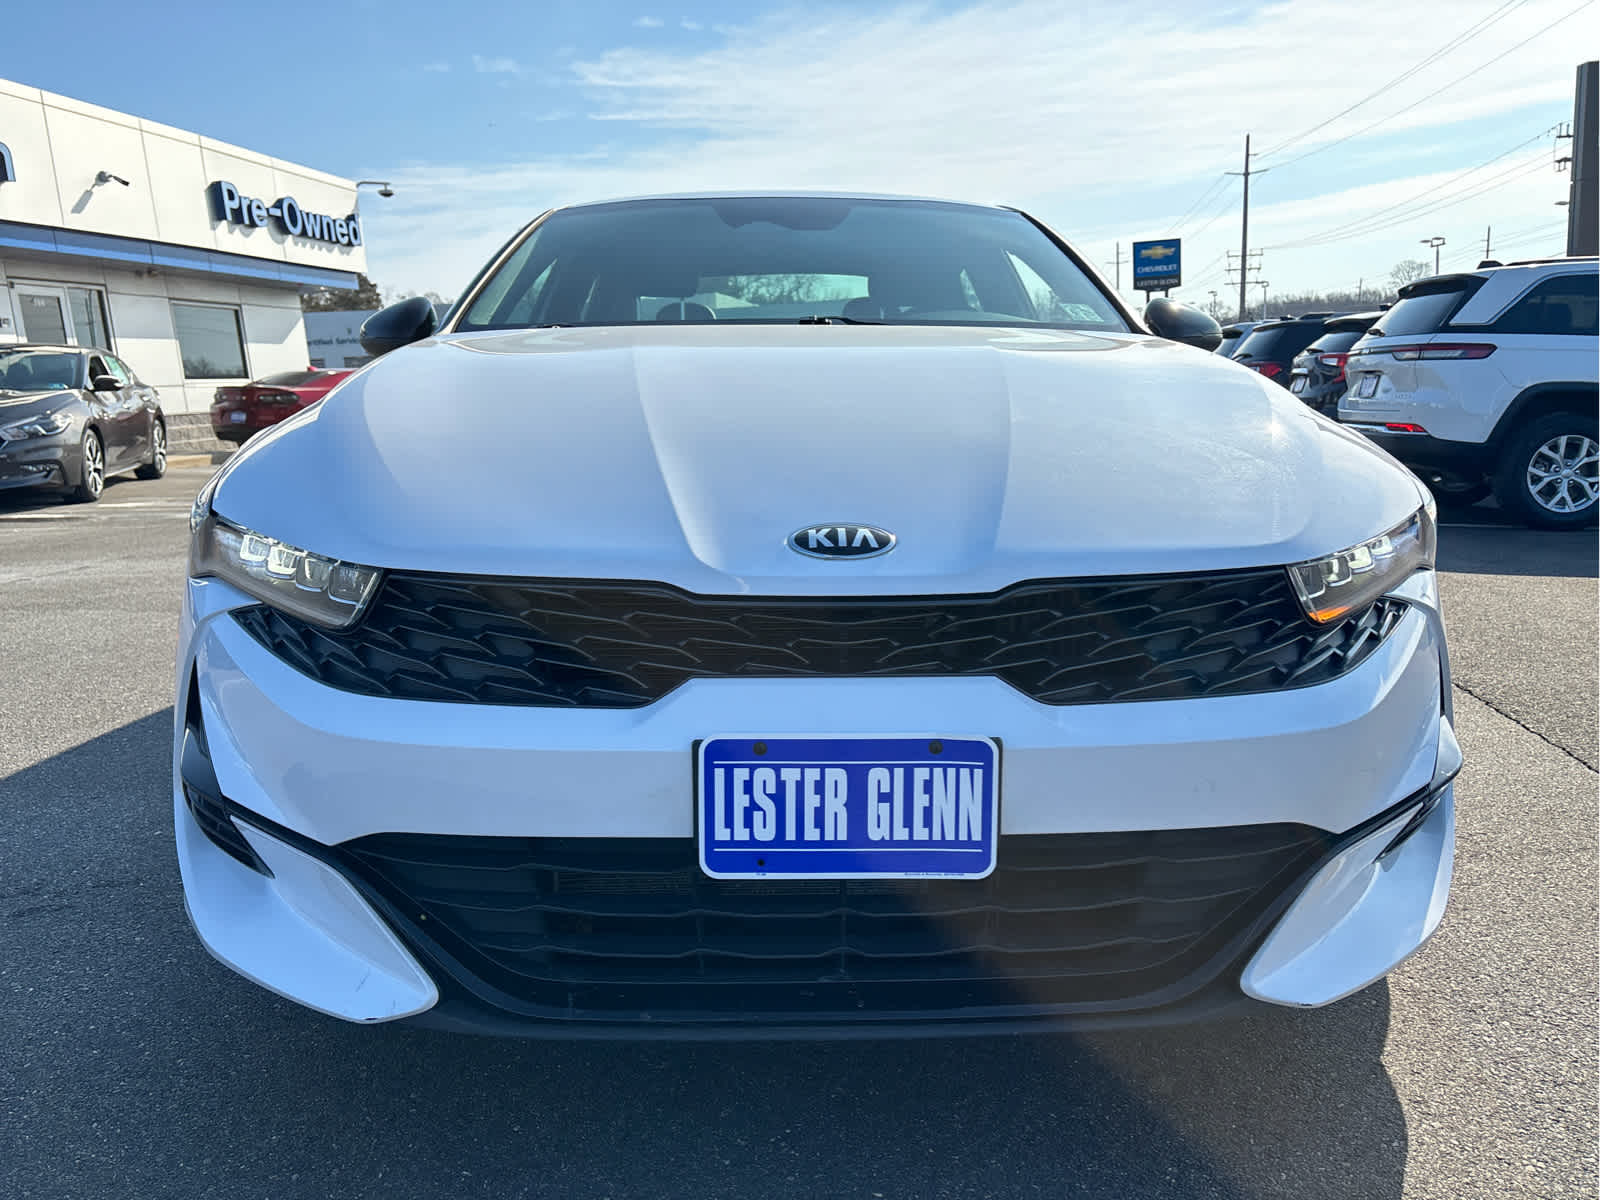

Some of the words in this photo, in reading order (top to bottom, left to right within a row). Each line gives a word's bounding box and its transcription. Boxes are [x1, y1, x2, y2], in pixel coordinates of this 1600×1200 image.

[219, 181, 362, 246] Pre-Owned
[807, 527, 880, 549] KIA
[714, 767, 848, 841] LESTER
[867, 767, 983, 841] GLENN
